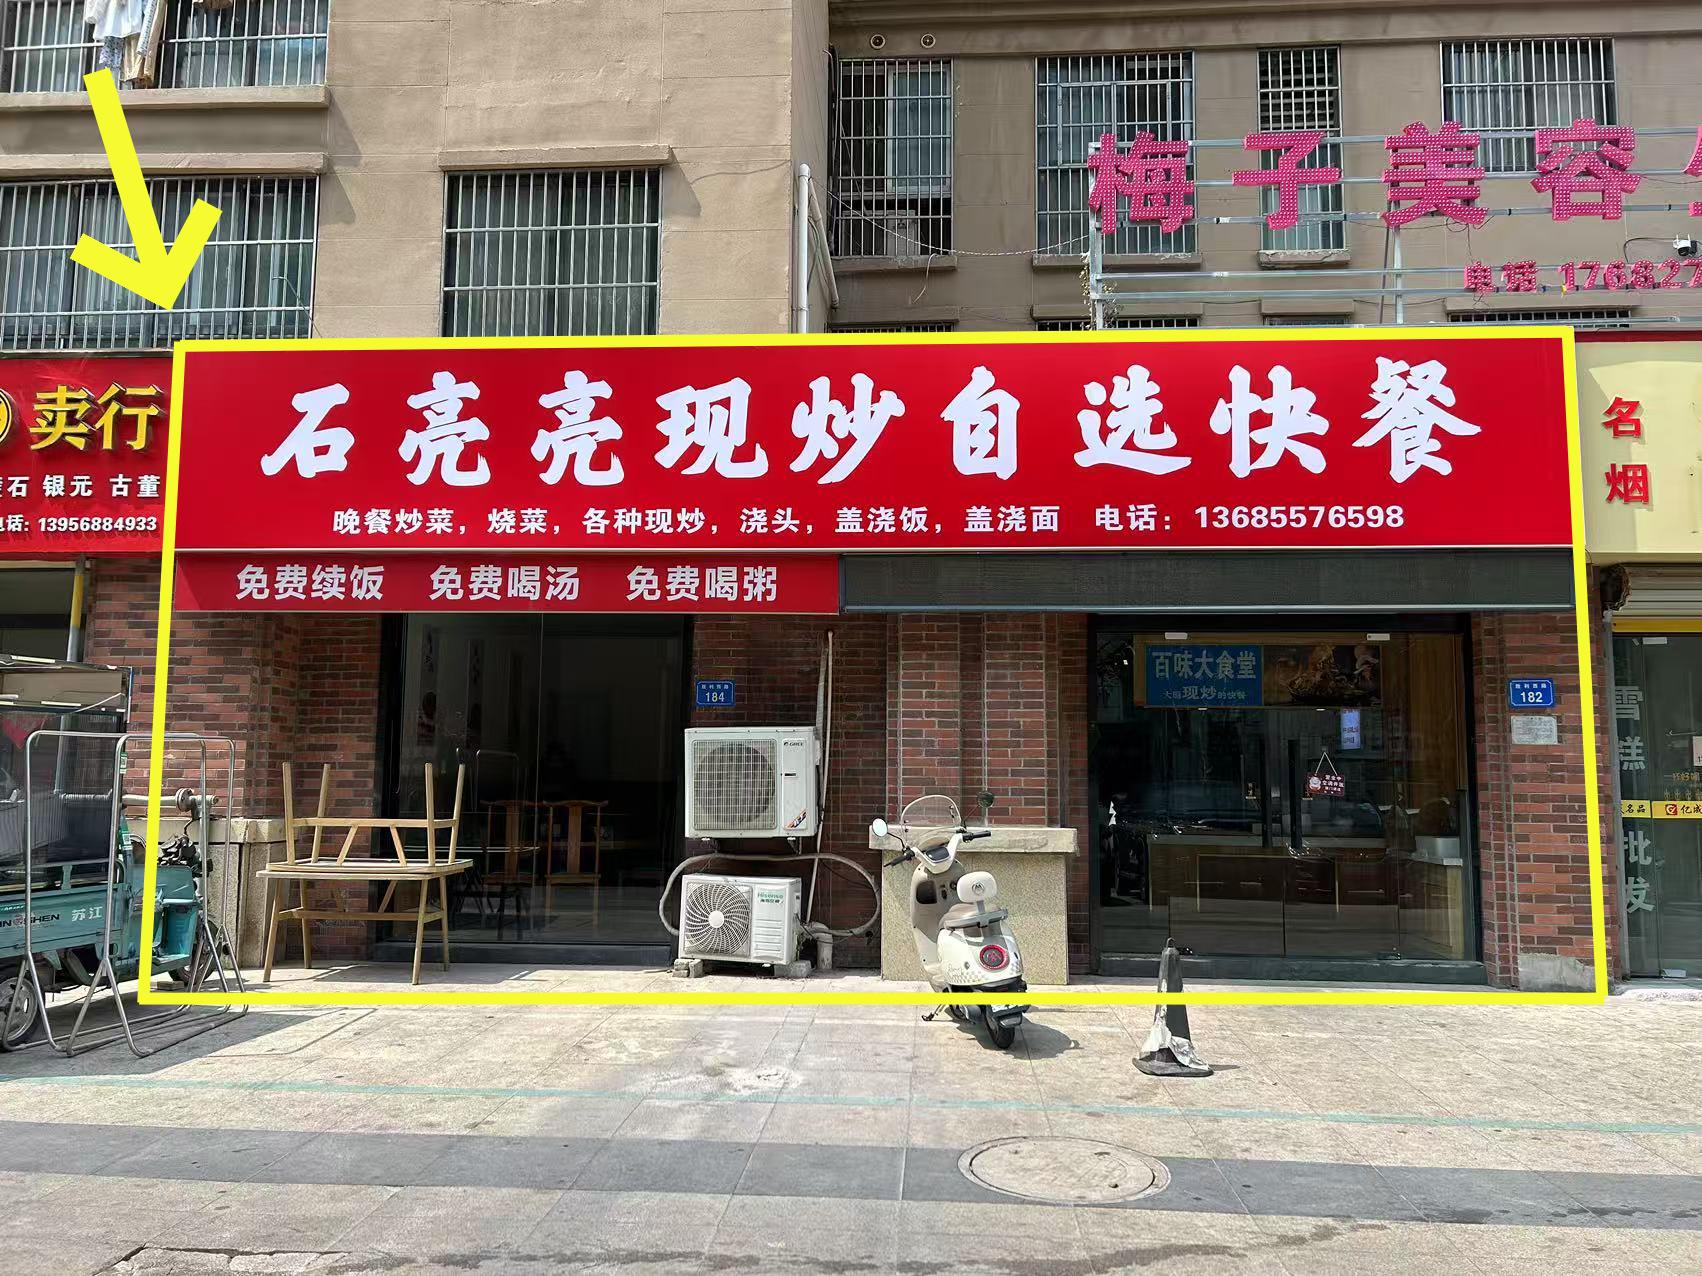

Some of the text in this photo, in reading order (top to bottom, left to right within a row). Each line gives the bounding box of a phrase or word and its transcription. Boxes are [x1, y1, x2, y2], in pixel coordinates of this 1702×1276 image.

[1088, 117, 1702, 234] 梅子美容
[29, 384, 158, 451] 卖行
[260, 356, 1482, 487] 石亮亮现炒自选快餐
[1603, 397, 1650, 504] 名烟
[0, 473, 161, 498] 石 银元 古董
[235, 563, 778, 602] 免费续饭 免费喝汤 免费喝粥
[1151, 649, 1256, 679] 百味大食堂
[705, 691, 725, 703] 184
[1520, 691, 1543, 703] 182
[1620, 803, 1646, 814] 名品
[71, 906, 103, 922] 苏江
